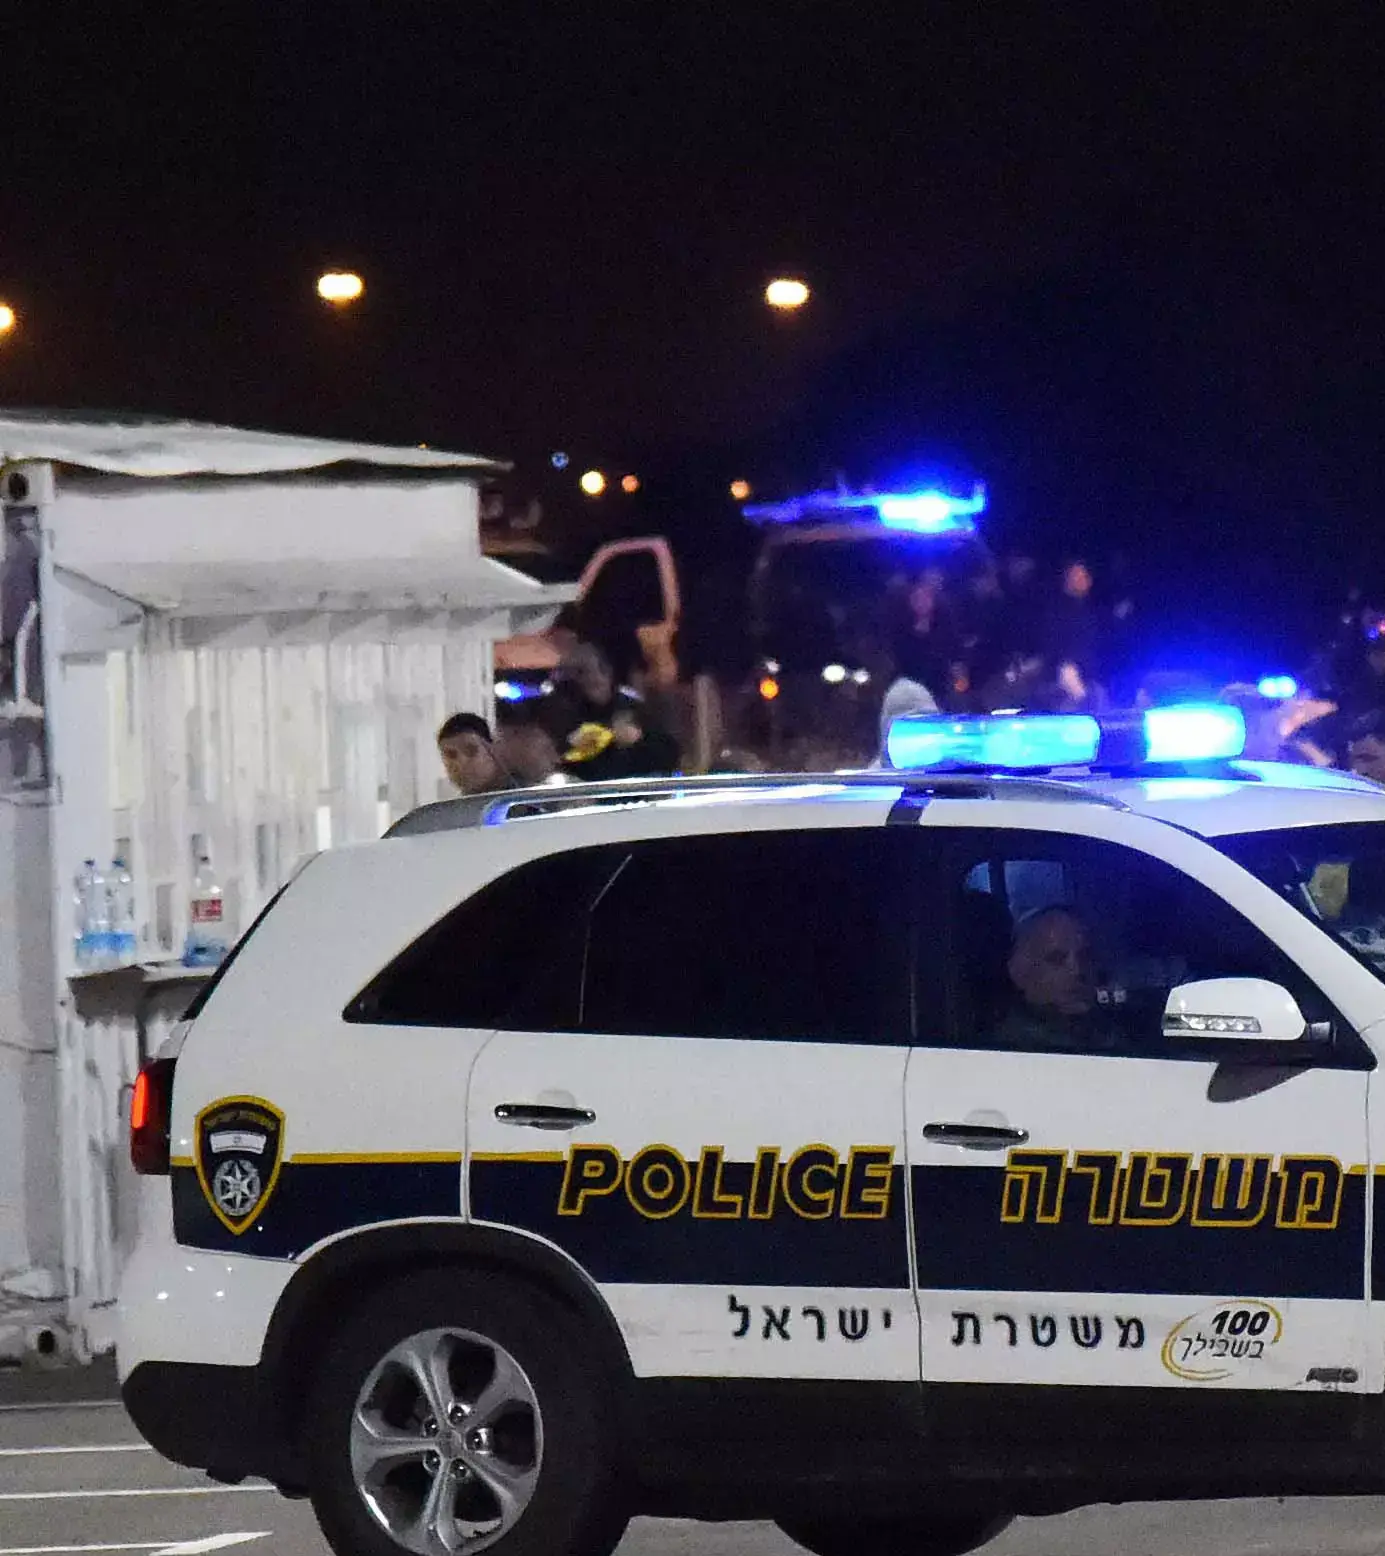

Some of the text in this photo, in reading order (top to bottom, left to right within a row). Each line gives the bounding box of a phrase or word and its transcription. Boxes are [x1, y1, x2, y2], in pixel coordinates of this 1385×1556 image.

[557, 1143, 896, 1220] POLICE
[1000, 1148, 1344, 1229] משטרה
[727, 1293, 1146, 1349] משטרת ישראל
[1180, 1331, 1265, 1362] בשבילך
[1212, 1310, 1271, 1336] 100
